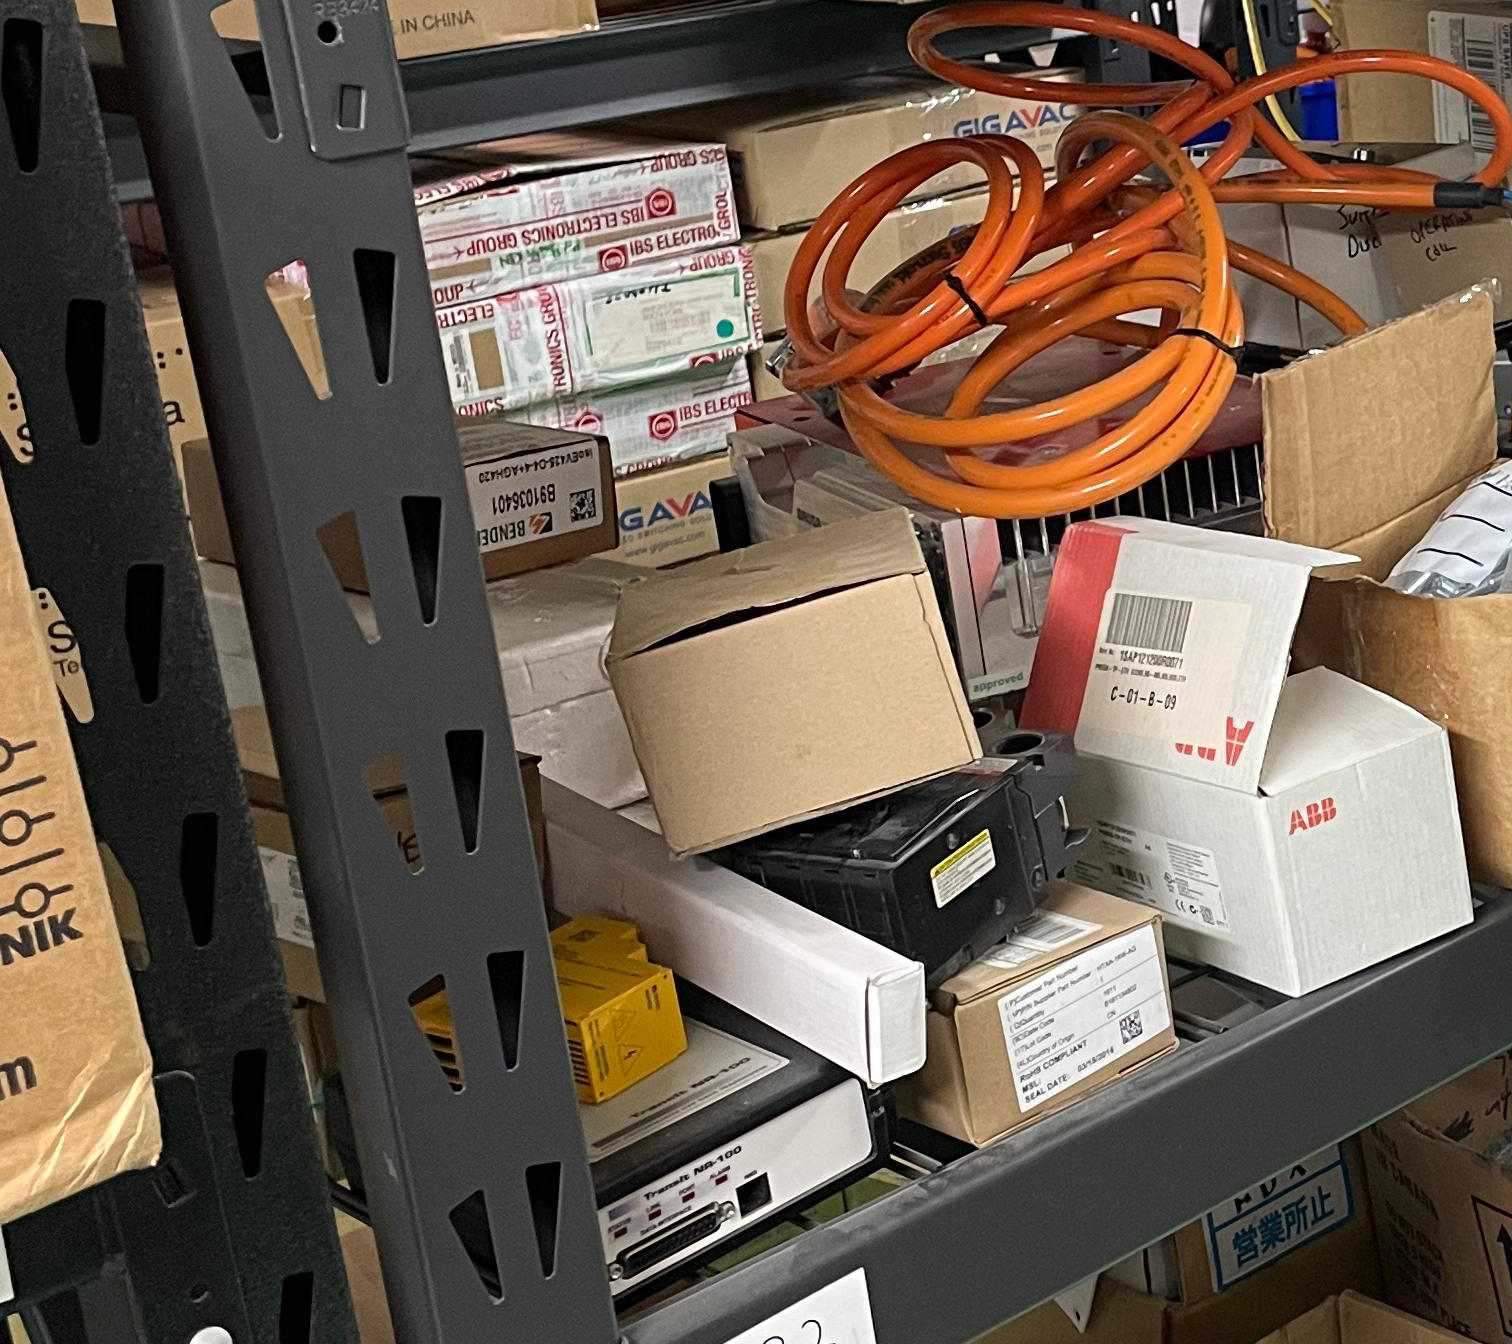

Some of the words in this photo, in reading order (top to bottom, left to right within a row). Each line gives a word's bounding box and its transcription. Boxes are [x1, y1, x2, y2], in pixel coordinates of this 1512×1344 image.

[422, 9, 475, 32] CHINA
[622, 206, 645, 225] IBS
[522, 213, 618, 242] ELECTRONICS
[466, 234, 518, 257] GROUP
[630, 238, 653, 256] IBS
[679, 403, 702, 422] IBS
[491, 483, 556, 516] B91036401
[973, 672, 1024, 693] approved
[1110, 686, 1177, 710] C-01-B-09
[1289, 797, 1337, 836] ABB
[643, 1173, 690, 1201] Transit
[694, 1145, 743, 1176] NA-100
